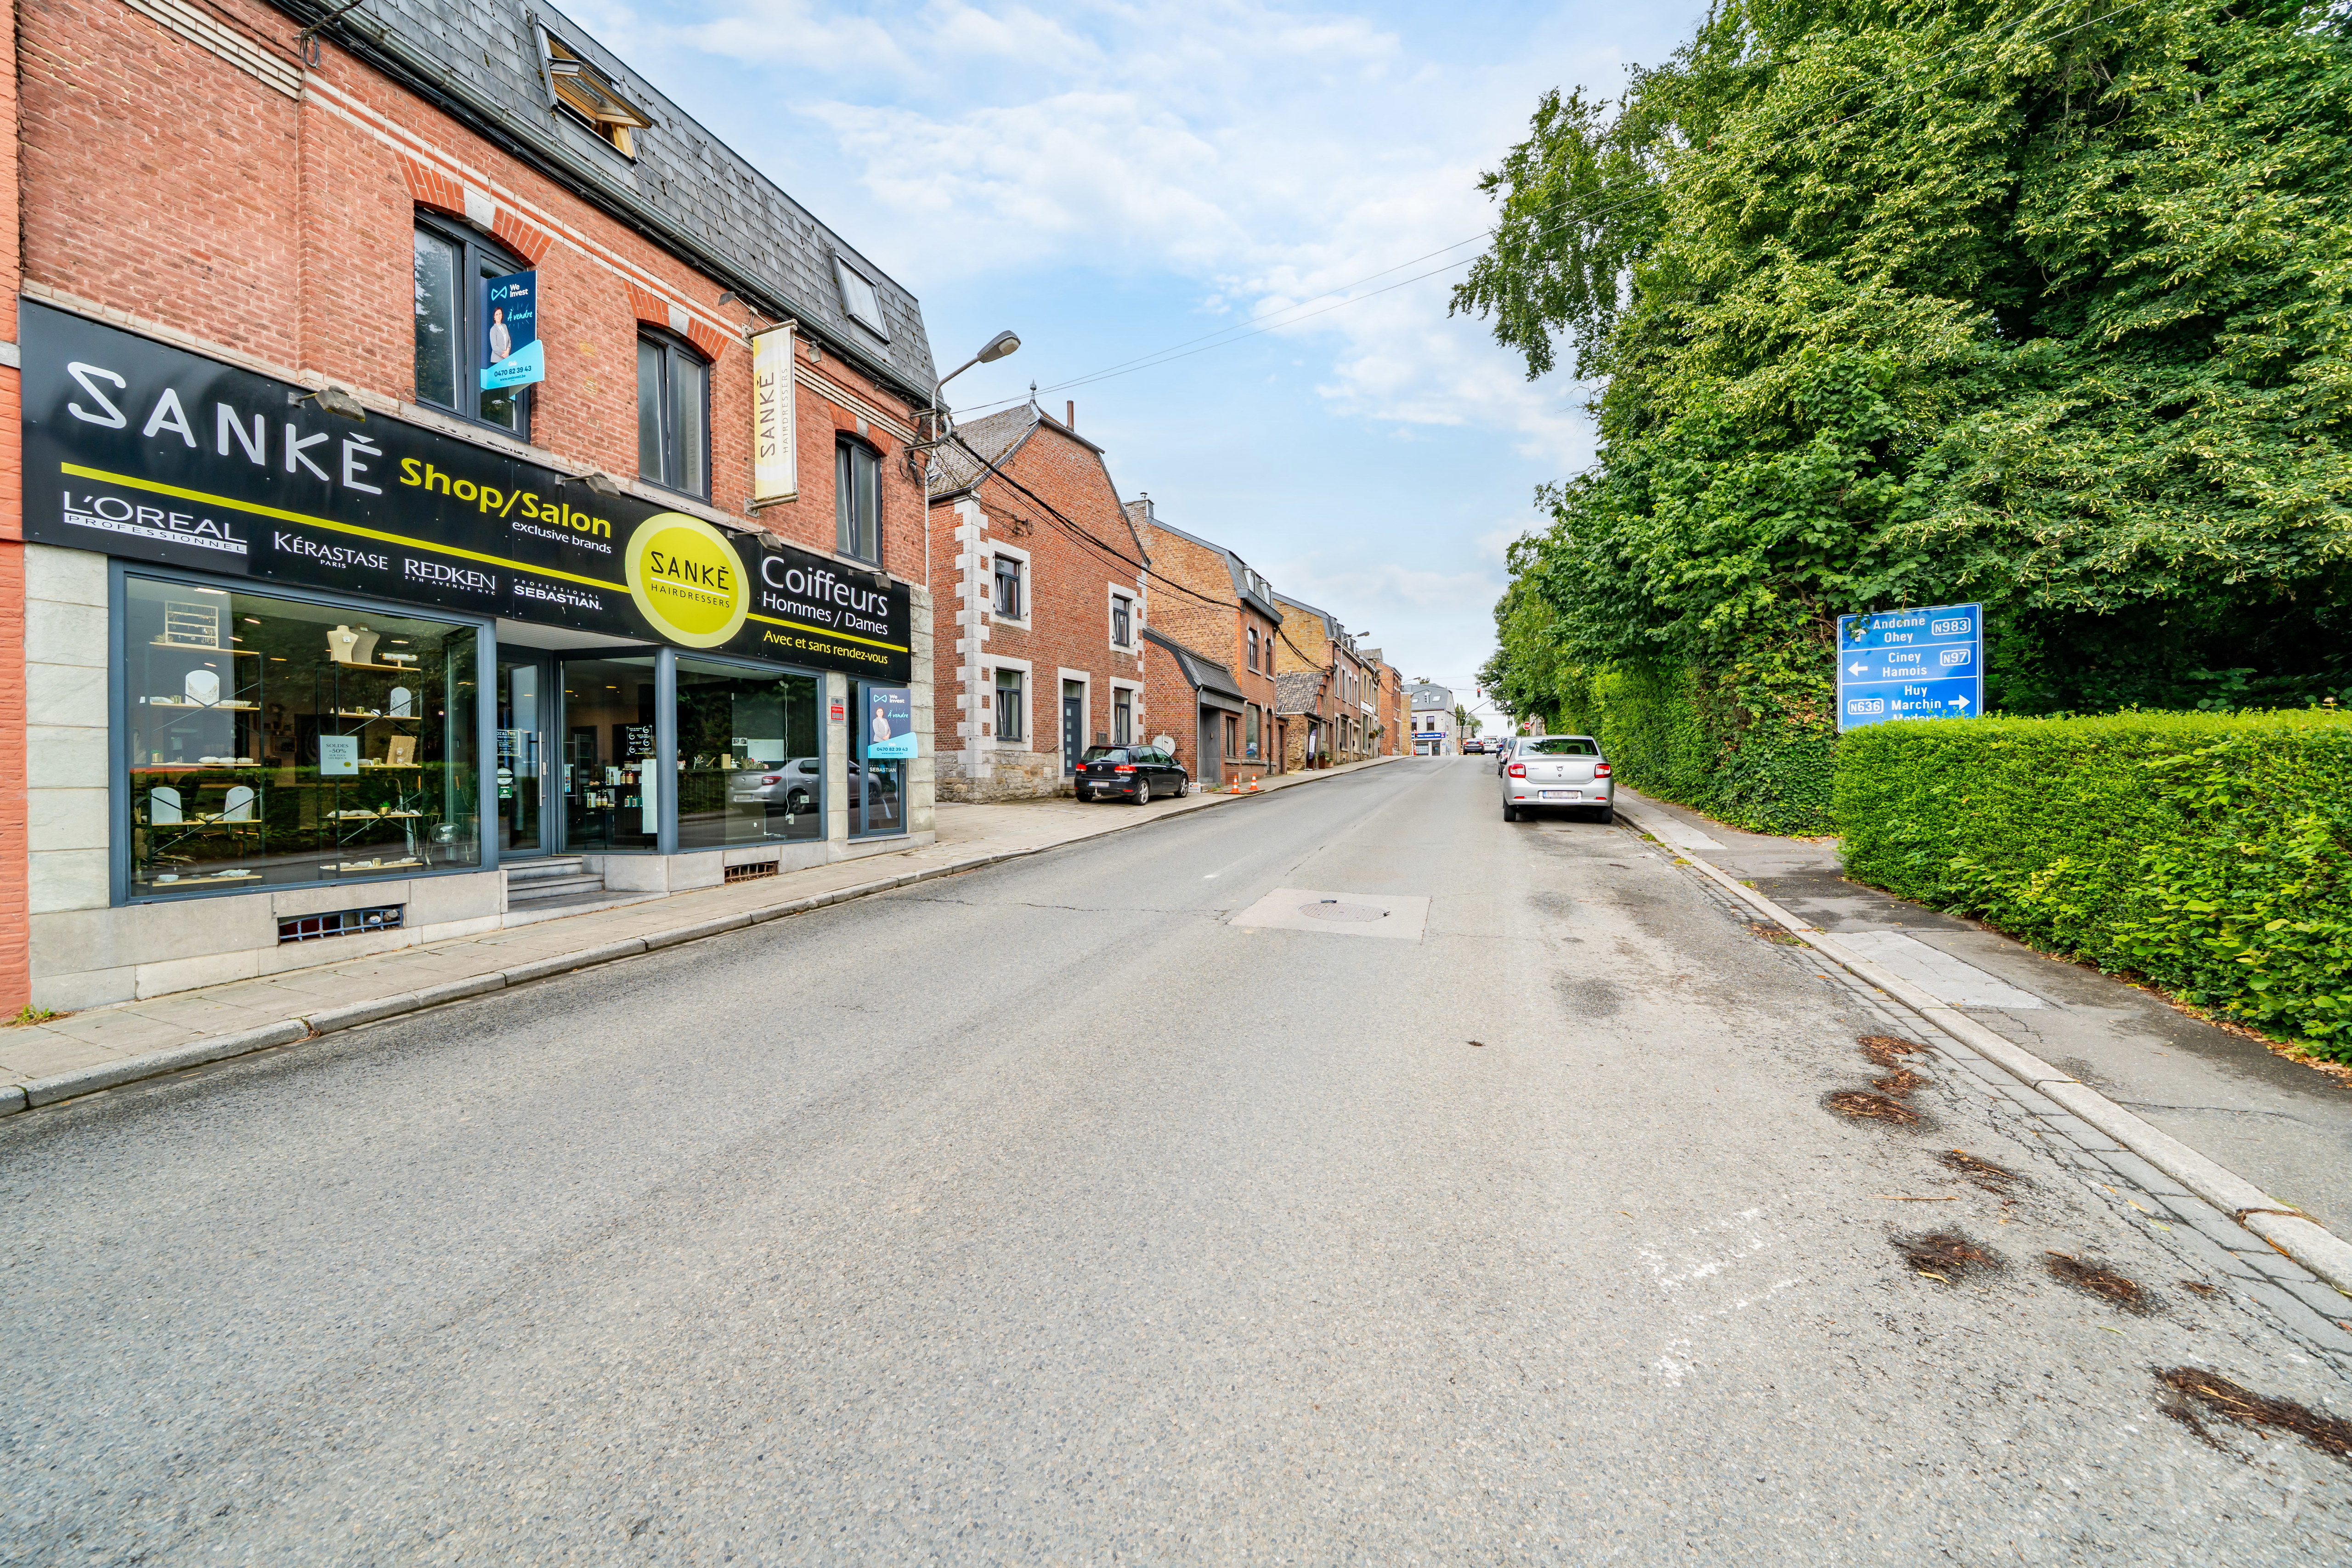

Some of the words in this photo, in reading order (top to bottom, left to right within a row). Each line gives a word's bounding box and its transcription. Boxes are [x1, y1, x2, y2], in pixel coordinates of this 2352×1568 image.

[510, 289, 528, 298] Invest
[513, 309, 533, 320] vendre
[69, 515, 244, 552] PROFESSIONNEL
[512, 521, 569, 543] exclusive
[572, 535, 611, 554] brands
[275, 532, 388, 570] KÉRASTASE
[321, 560, 346, 568] PARIS
[404, 559, 495, 589] REDKEN
[432, 581, 470, 590] AVENUE
[514, 578, 598, 599] PROFESSIONAL
[762, 556, 888, 616] Coiffeurs
[651, 583, 729, 608] HAIRDRESSERS
[763, 591, 831, 622] Hommes
[846, 612, 888, 635] Dames
[1873, 617, 1925, 630] Andenne
[1935, 620, 1968, 633] N983
[1884, 632, 1913, 643] Ohey
[763, 630, 792, 646] Avec
[795, 639, 806, 649] et
[808, 641, 831, 653] sans
[833, 646, 888, 664] rendez-vous
[1888, 652, 1921, 664] Ciney
[1943, 652, 1967, 663] N97
[1883, 665, 1927, 677] Hamois
[1905, 685, 1928, 697] Huy
[1850, 701, 1881, 713] N636
[1891, 699, 1941, 710] Marchin
